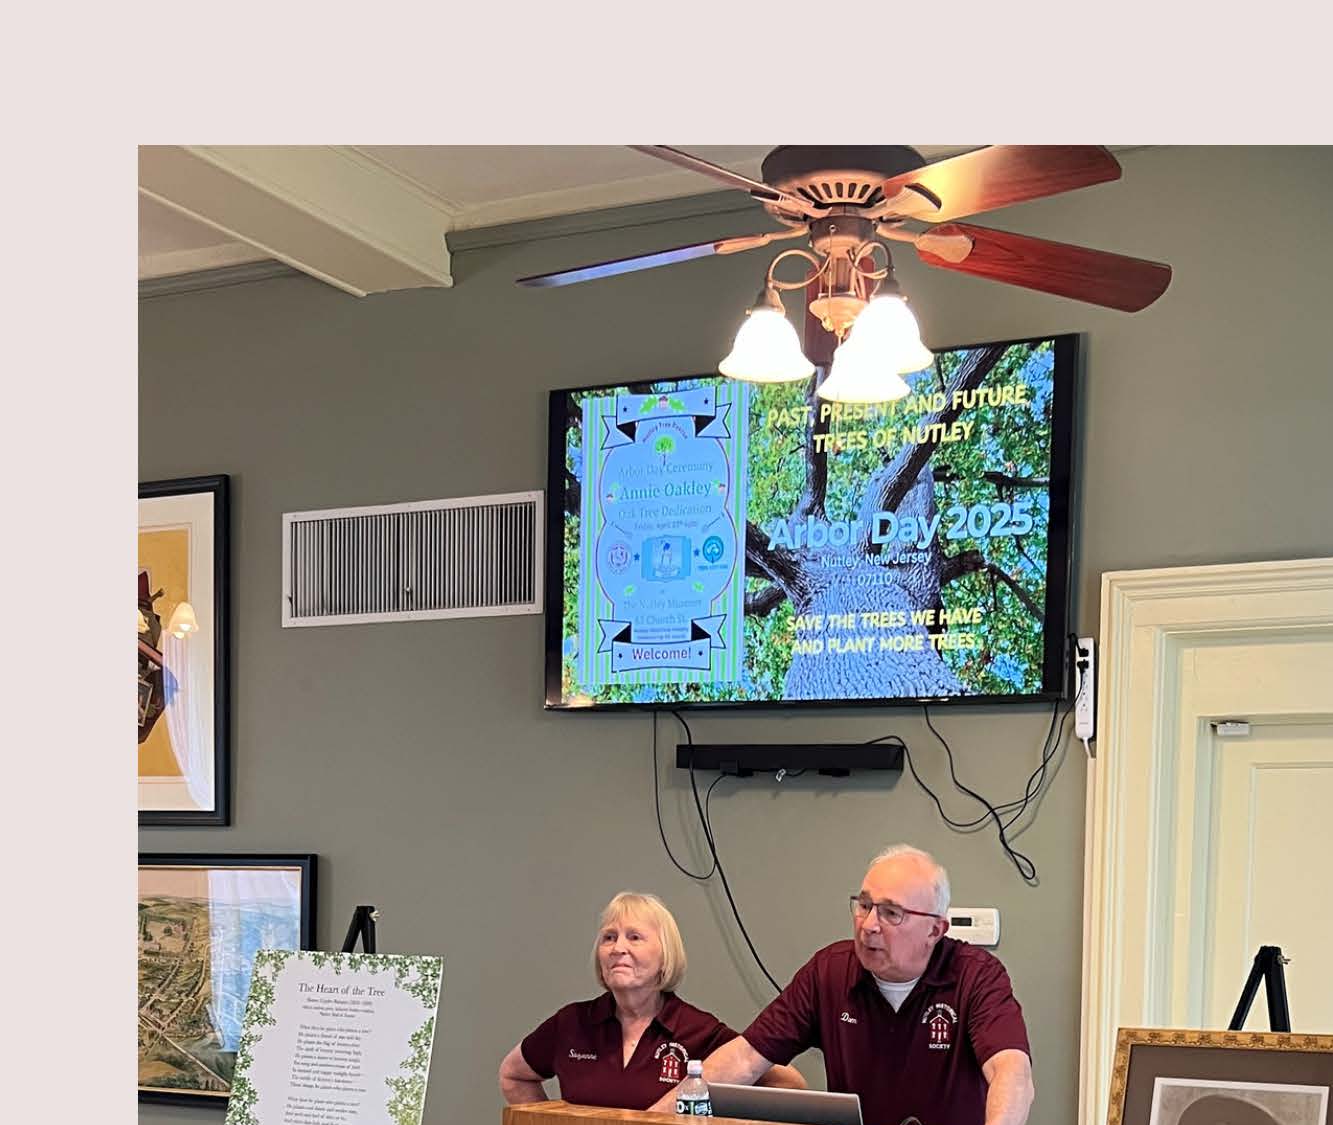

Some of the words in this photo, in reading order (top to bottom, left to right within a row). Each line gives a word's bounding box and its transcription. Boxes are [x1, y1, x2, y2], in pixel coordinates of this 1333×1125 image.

[821, 401, 896, 424] PRESENT
[906, 394, 946, 417] AND
[813, 431, 867, 453] TREES
[873, 429, 898, 448] OF
[903, 422, 975, 446] NUTLEY
[619, 484, 660, 500] Annie
[664, 480, 712, 498] Oakley
[768, 515, 863, 551] Arbor
[872, 511, 941, 549] Day
[947, 503, 1034, 540] 2025
[865, 553, 891, 566] New
[893, 551, 932, 569] Jersey
[858, 572, 893, 586] 07110
[787, 614, 823, 631] SAVE
[827, 613, 856, 630] THE
[861, 611, 905, 628] TREES
[911, 610, 936, 626] WE
[939, 608, 982, 625] HAVE
[632, 647, 692, 660] Welcome!
[792, 639, 825, 655] AND
[828, 637, 875, 654] PLANT
[880, 635, 925, 652] MORE
[298, 982, 314, 993] The
[316, 983, 339, 994] Heart
[341, 984, 351, 995] of
[352, 985, 365, 996] the
[367, 986, 385, 997] Tree
